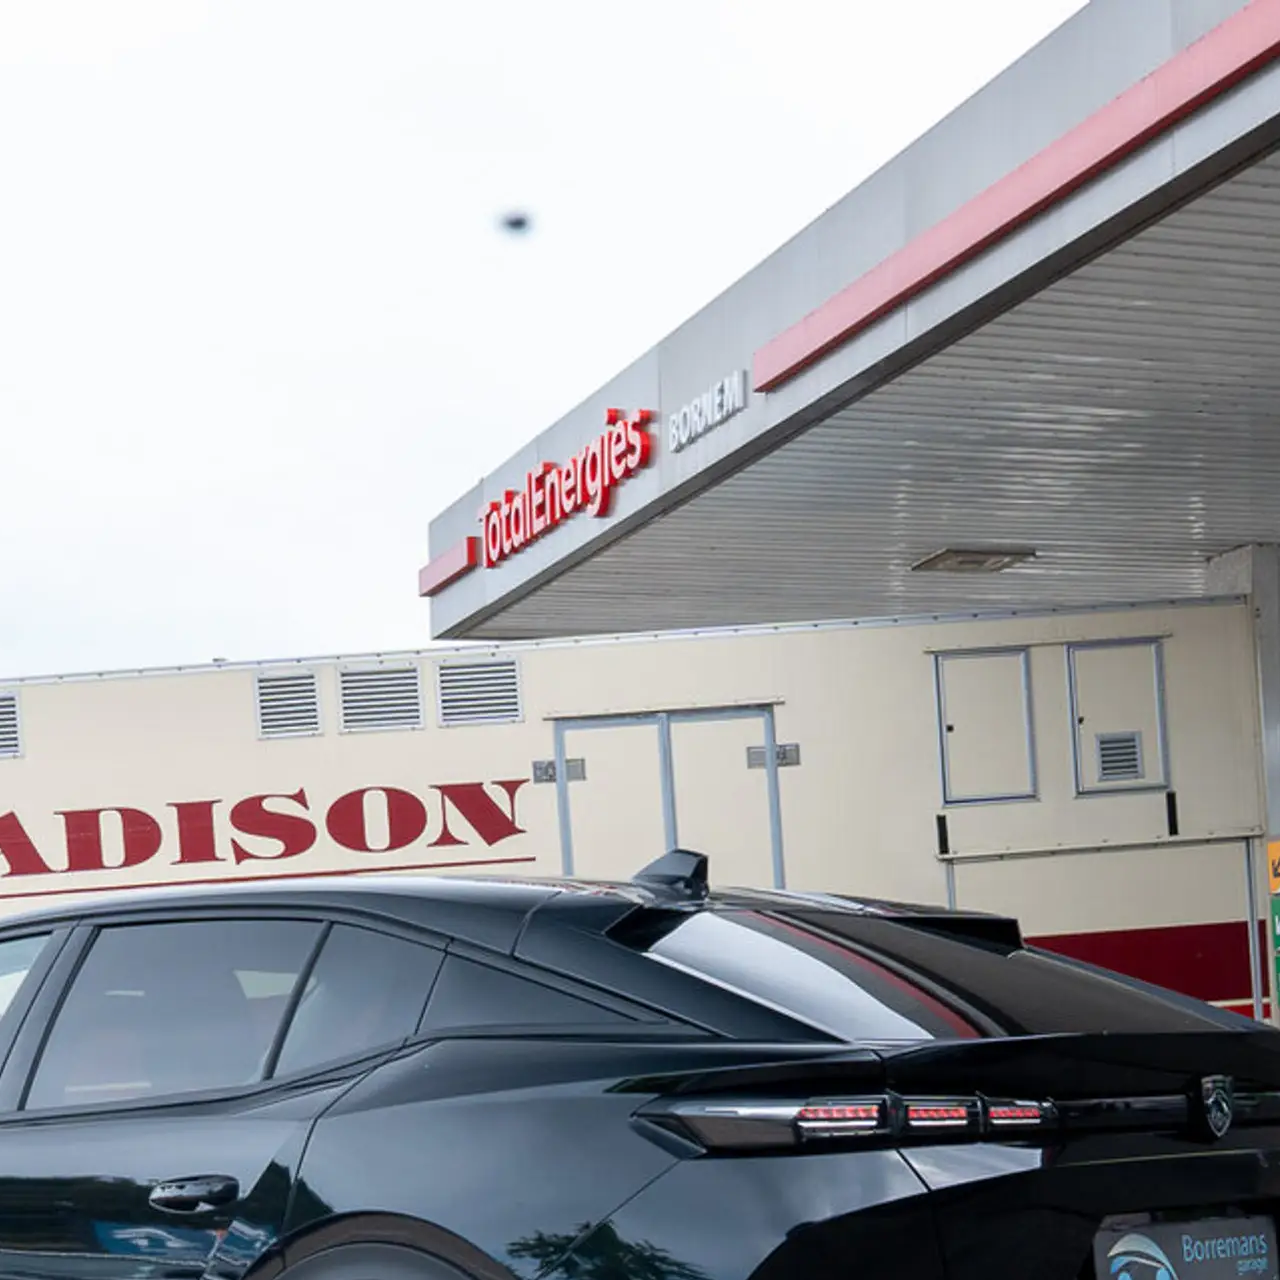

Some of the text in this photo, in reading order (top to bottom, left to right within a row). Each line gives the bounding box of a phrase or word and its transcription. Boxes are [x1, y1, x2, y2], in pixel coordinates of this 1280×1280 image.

[477, 370, 747, 568] TotalEnergies BORNEM
[1181, 1233, 1269, 1262] Borremans
[1236, 1259, 1269, 1276] garage
